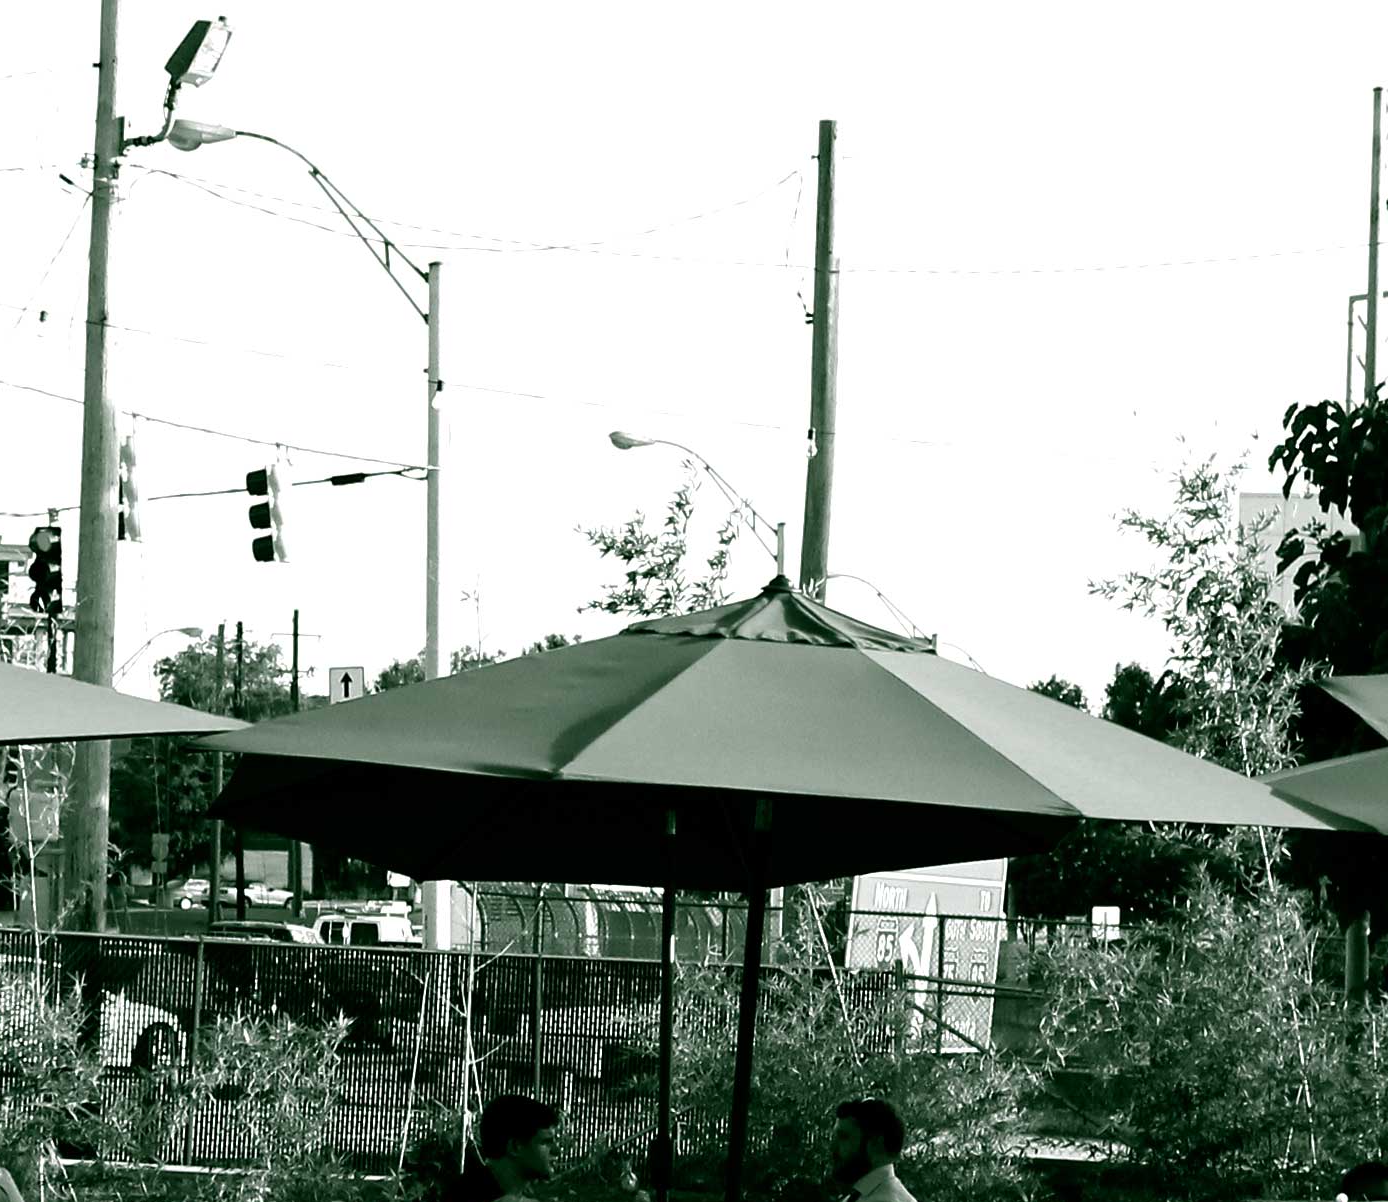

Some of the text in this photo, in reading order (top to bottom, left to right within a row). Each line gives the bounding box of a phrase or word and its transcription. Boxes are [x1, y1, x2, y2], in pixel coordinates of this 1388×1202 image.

[874, 881, 908, 911] NORTH
[979, 890, 991, 912] TO
[876, 934, 894, 963] 85
